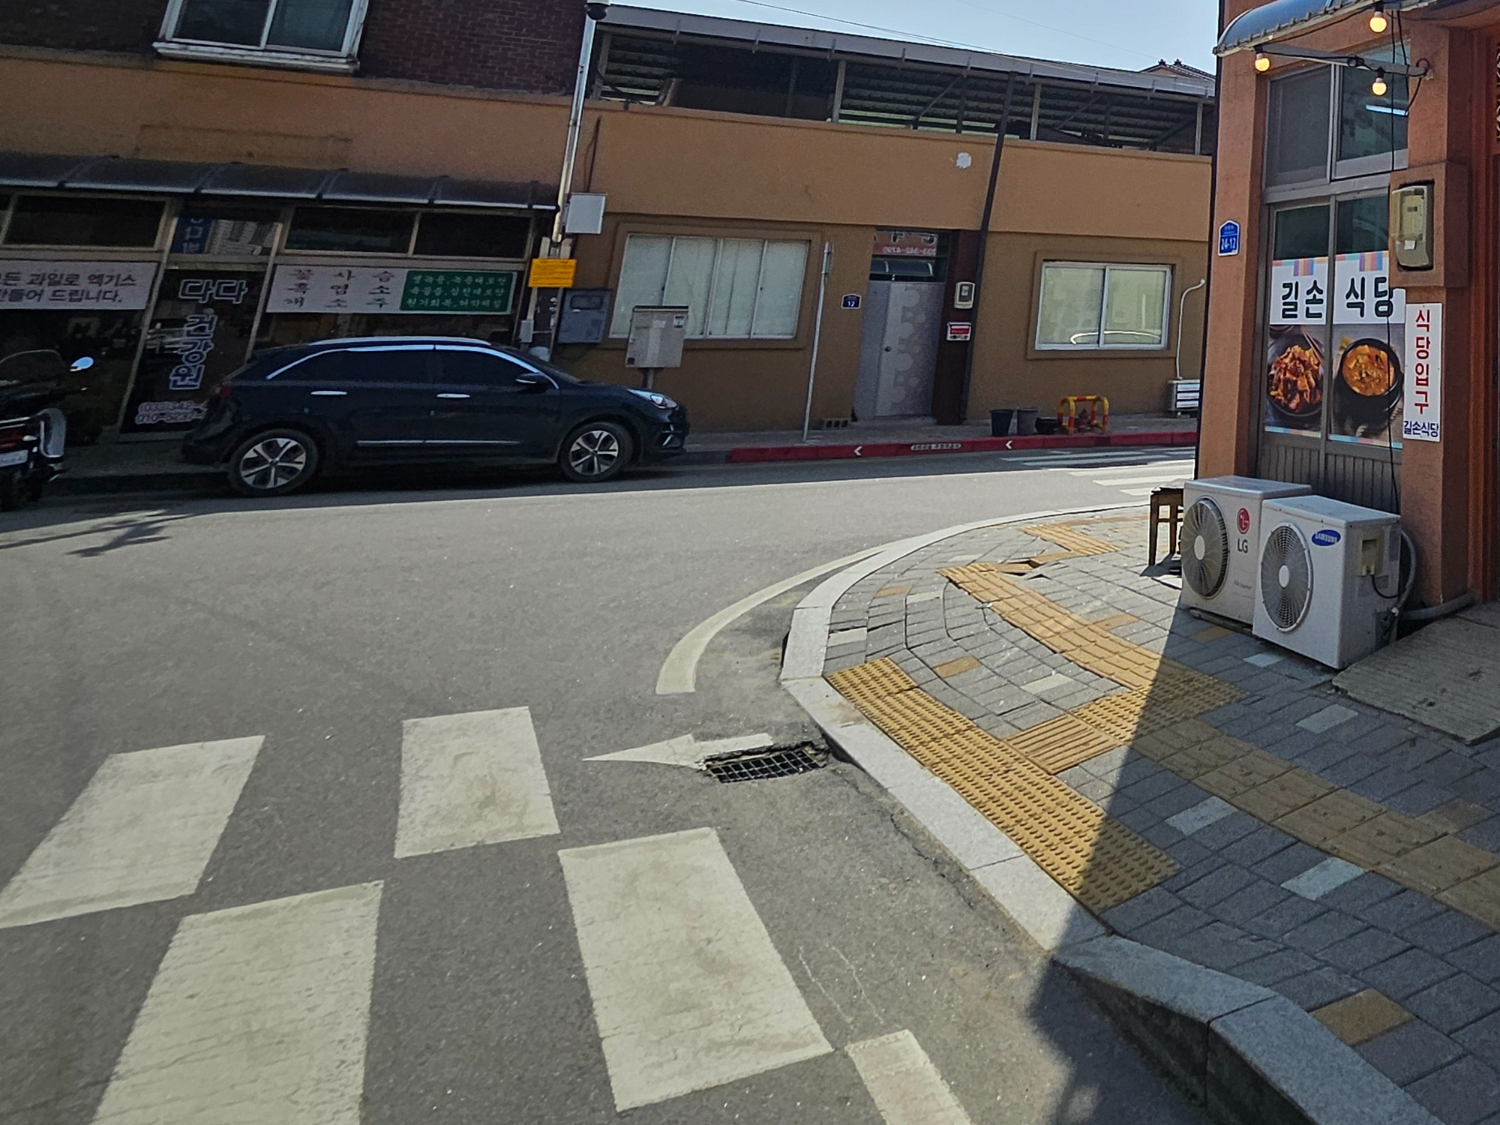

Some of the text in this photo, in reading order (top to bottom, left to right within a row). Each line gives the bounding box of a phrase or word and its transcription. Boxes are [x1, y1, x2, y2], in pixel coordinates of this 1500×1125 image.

[0, 271, 21, 287] 든
[26, 273, 80, 287] 과일로
[48, 289, 122, 303] 드립니다.
[179, 278, 248, 304] 다다
[1281, 276, 1394, 319] 길손 식당
[169, 315, 218, 390] 건강원
[1414, 309, 1431, 415] 식당입구
[1403, 420, 1439, 438] 길손식당
[1237, 538, 1248, 554] LG
[1314, 531, 1338, 544] SAMSUNG
